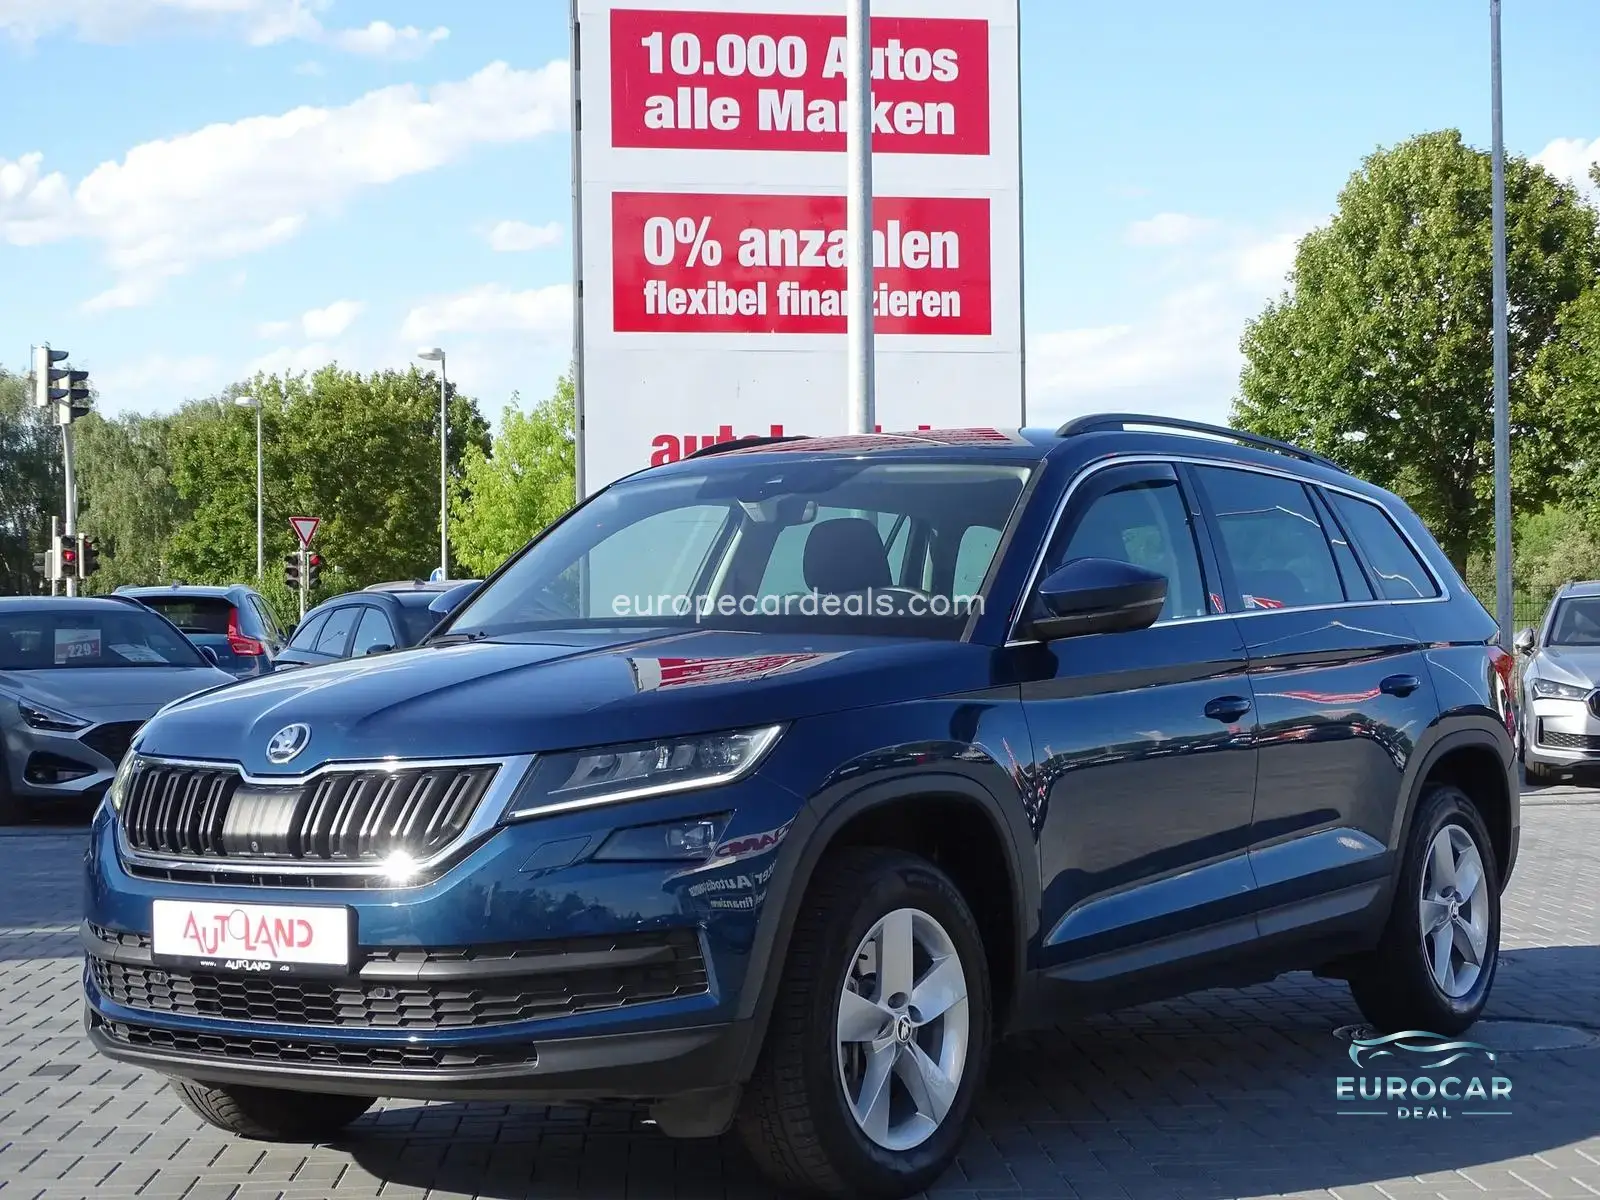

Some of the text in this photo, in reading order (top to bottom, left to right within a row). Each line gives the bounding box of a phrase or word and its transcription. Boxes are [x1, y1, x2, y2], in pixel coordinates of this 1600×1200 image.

[641, 31, 808, 79] 10.000
[643, 86, 741, 131] alle
[643, 215, 722, 267] 0%
[643, 280, 961, 317] flexibel finaieren
[67, 642, 92, 658] 229
